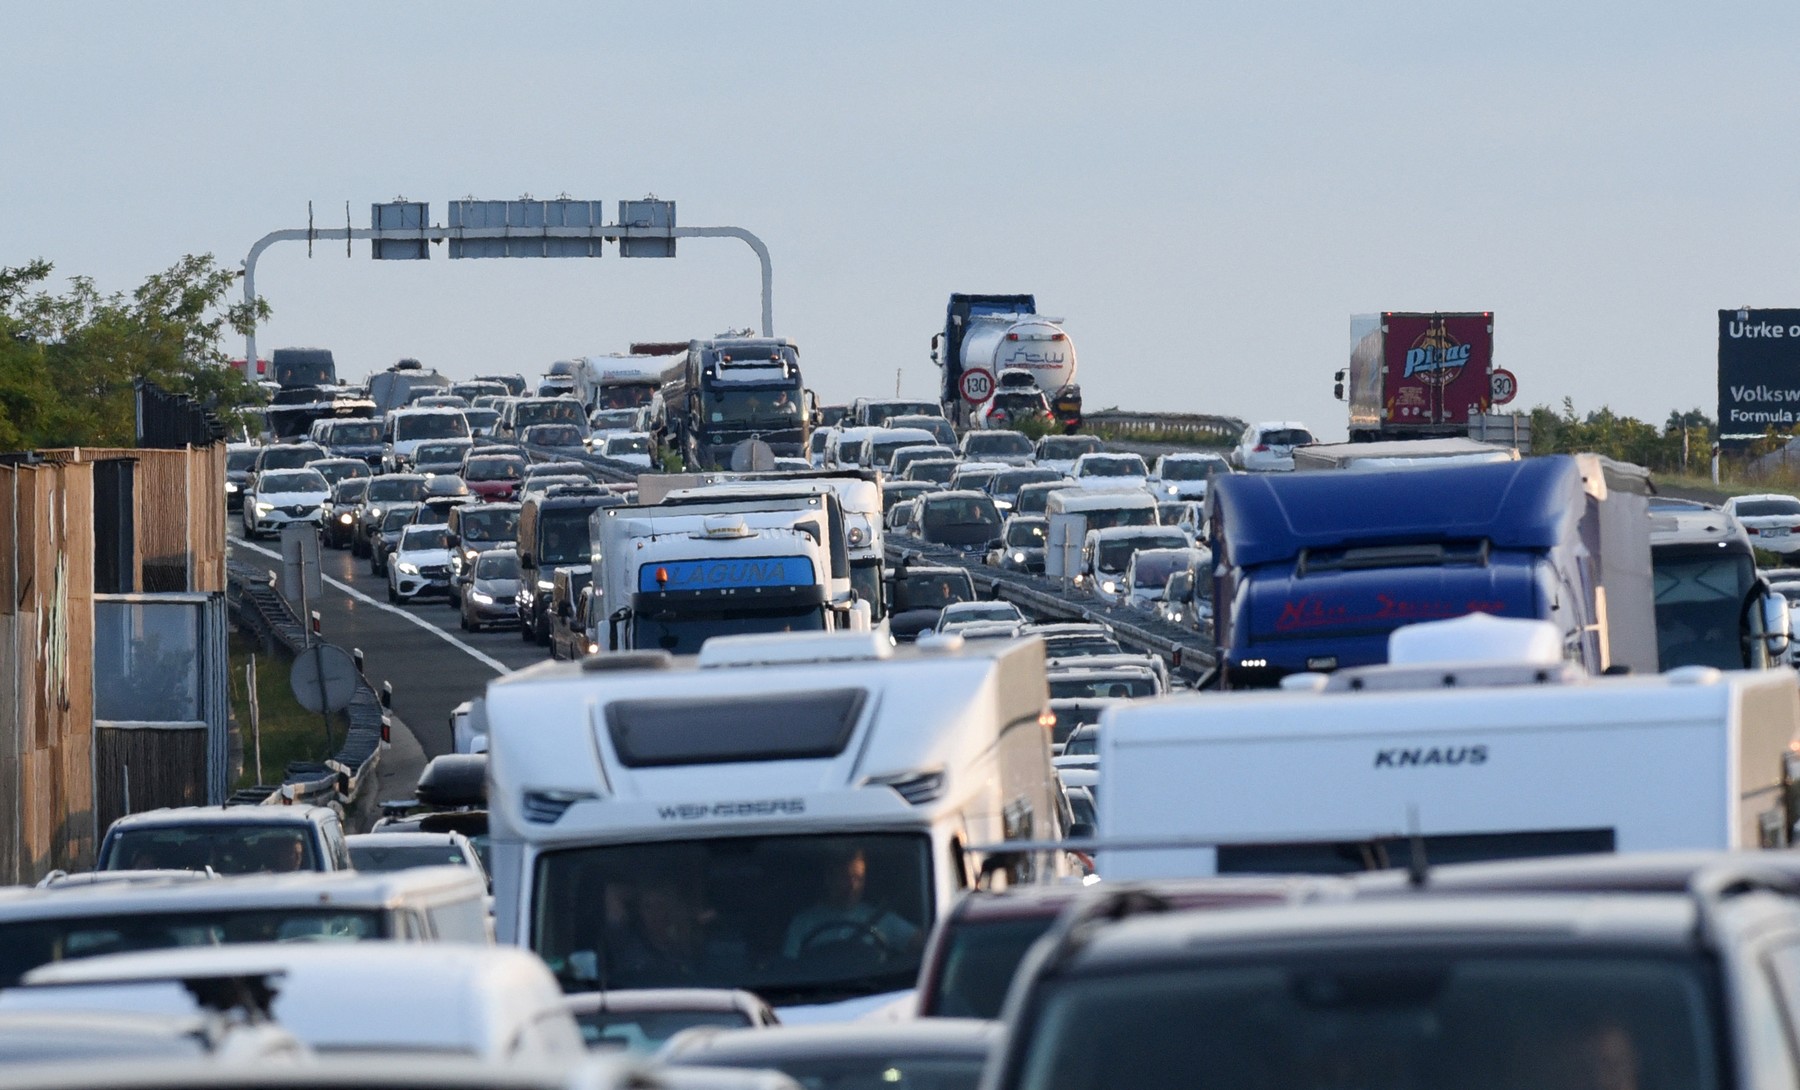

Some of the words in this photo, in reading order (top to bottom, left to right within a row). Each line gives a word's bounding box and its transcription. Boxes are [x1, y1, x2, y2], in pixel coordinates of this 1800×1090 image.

[1729, 321, 1784, 338] Utrke
[966, 377, 987, 393] 130
[1730, 408, 1793, 422] Formula
[1375, 745, 1488, 768] KNAUS
